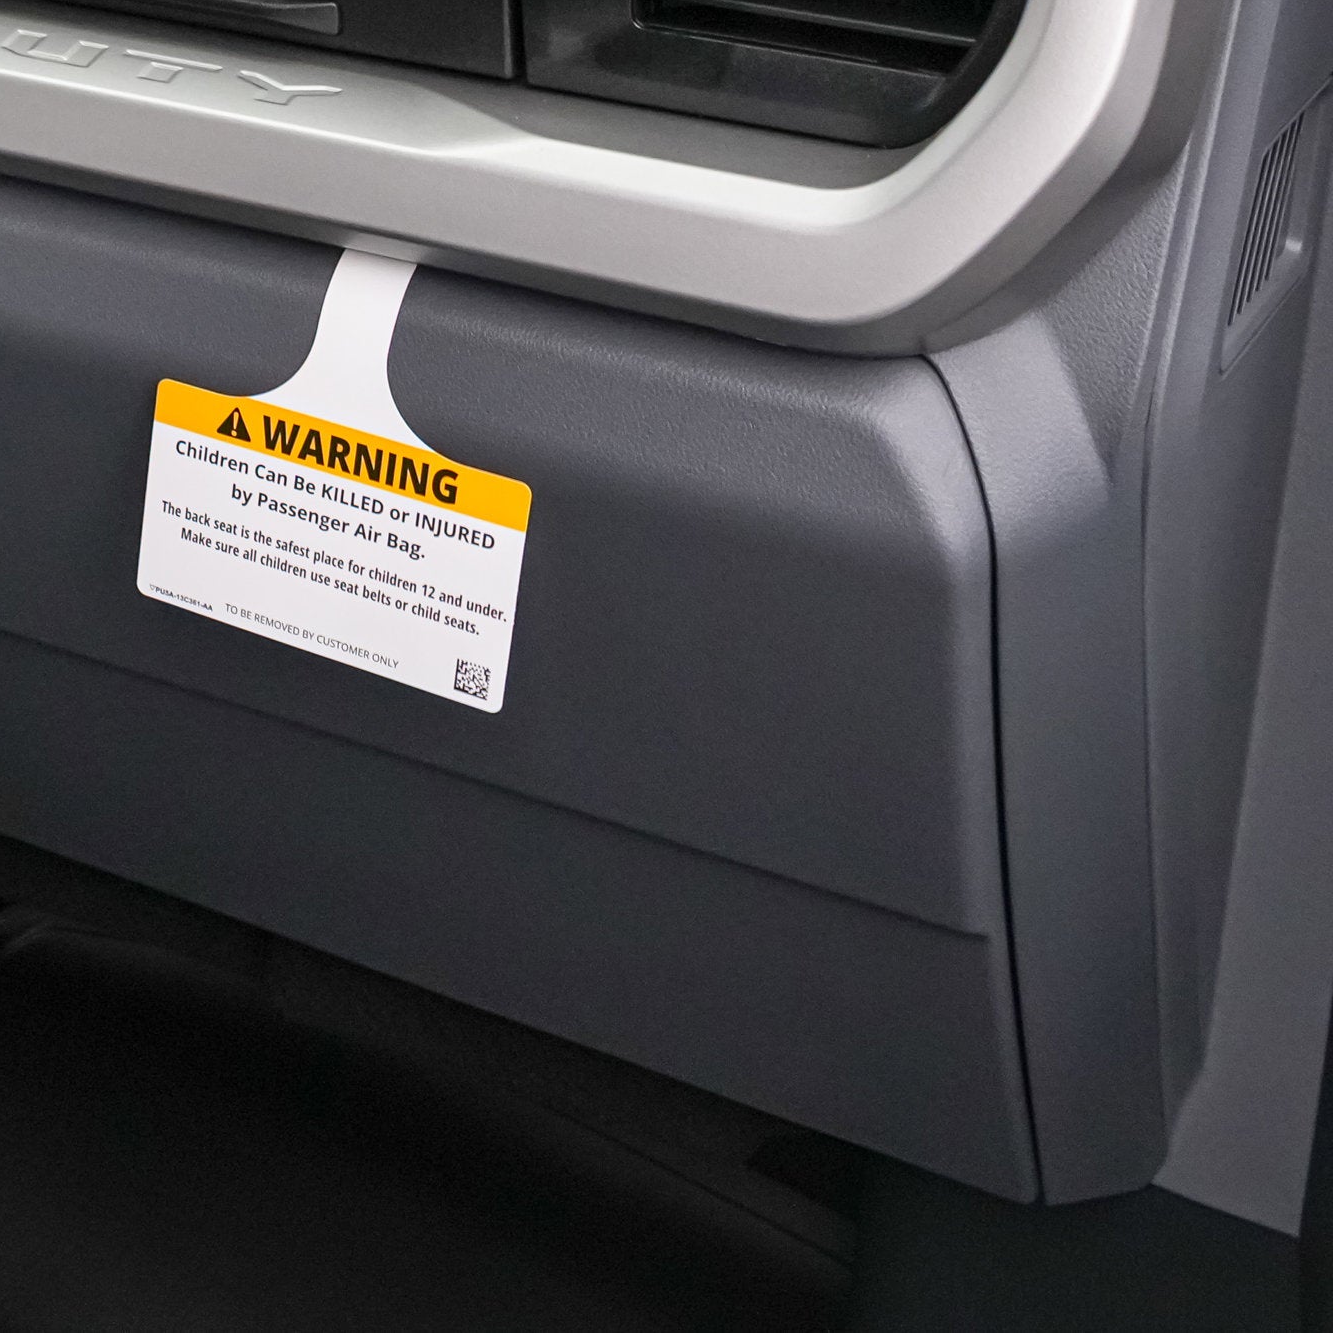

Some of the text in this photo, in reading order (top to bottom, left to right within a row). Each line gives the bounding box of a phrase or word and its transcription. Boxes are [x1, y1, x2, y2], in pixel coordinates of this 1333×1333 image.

[176, 440, 495, 549] Children Can Be KILLED or INJURED
[263, 415, 459, 504] WARNING
[162, 501, 507, 622] The back seat is the safest place for children 12 and under.
[231, 484, 425, 559] by Passenger Air Bag.
[181, 527, 479, 636] Make sure all children use seat belts or child seats.
[225, 603, 399, 669] TO BE REMOVED BY CUSTOMER ONLY
